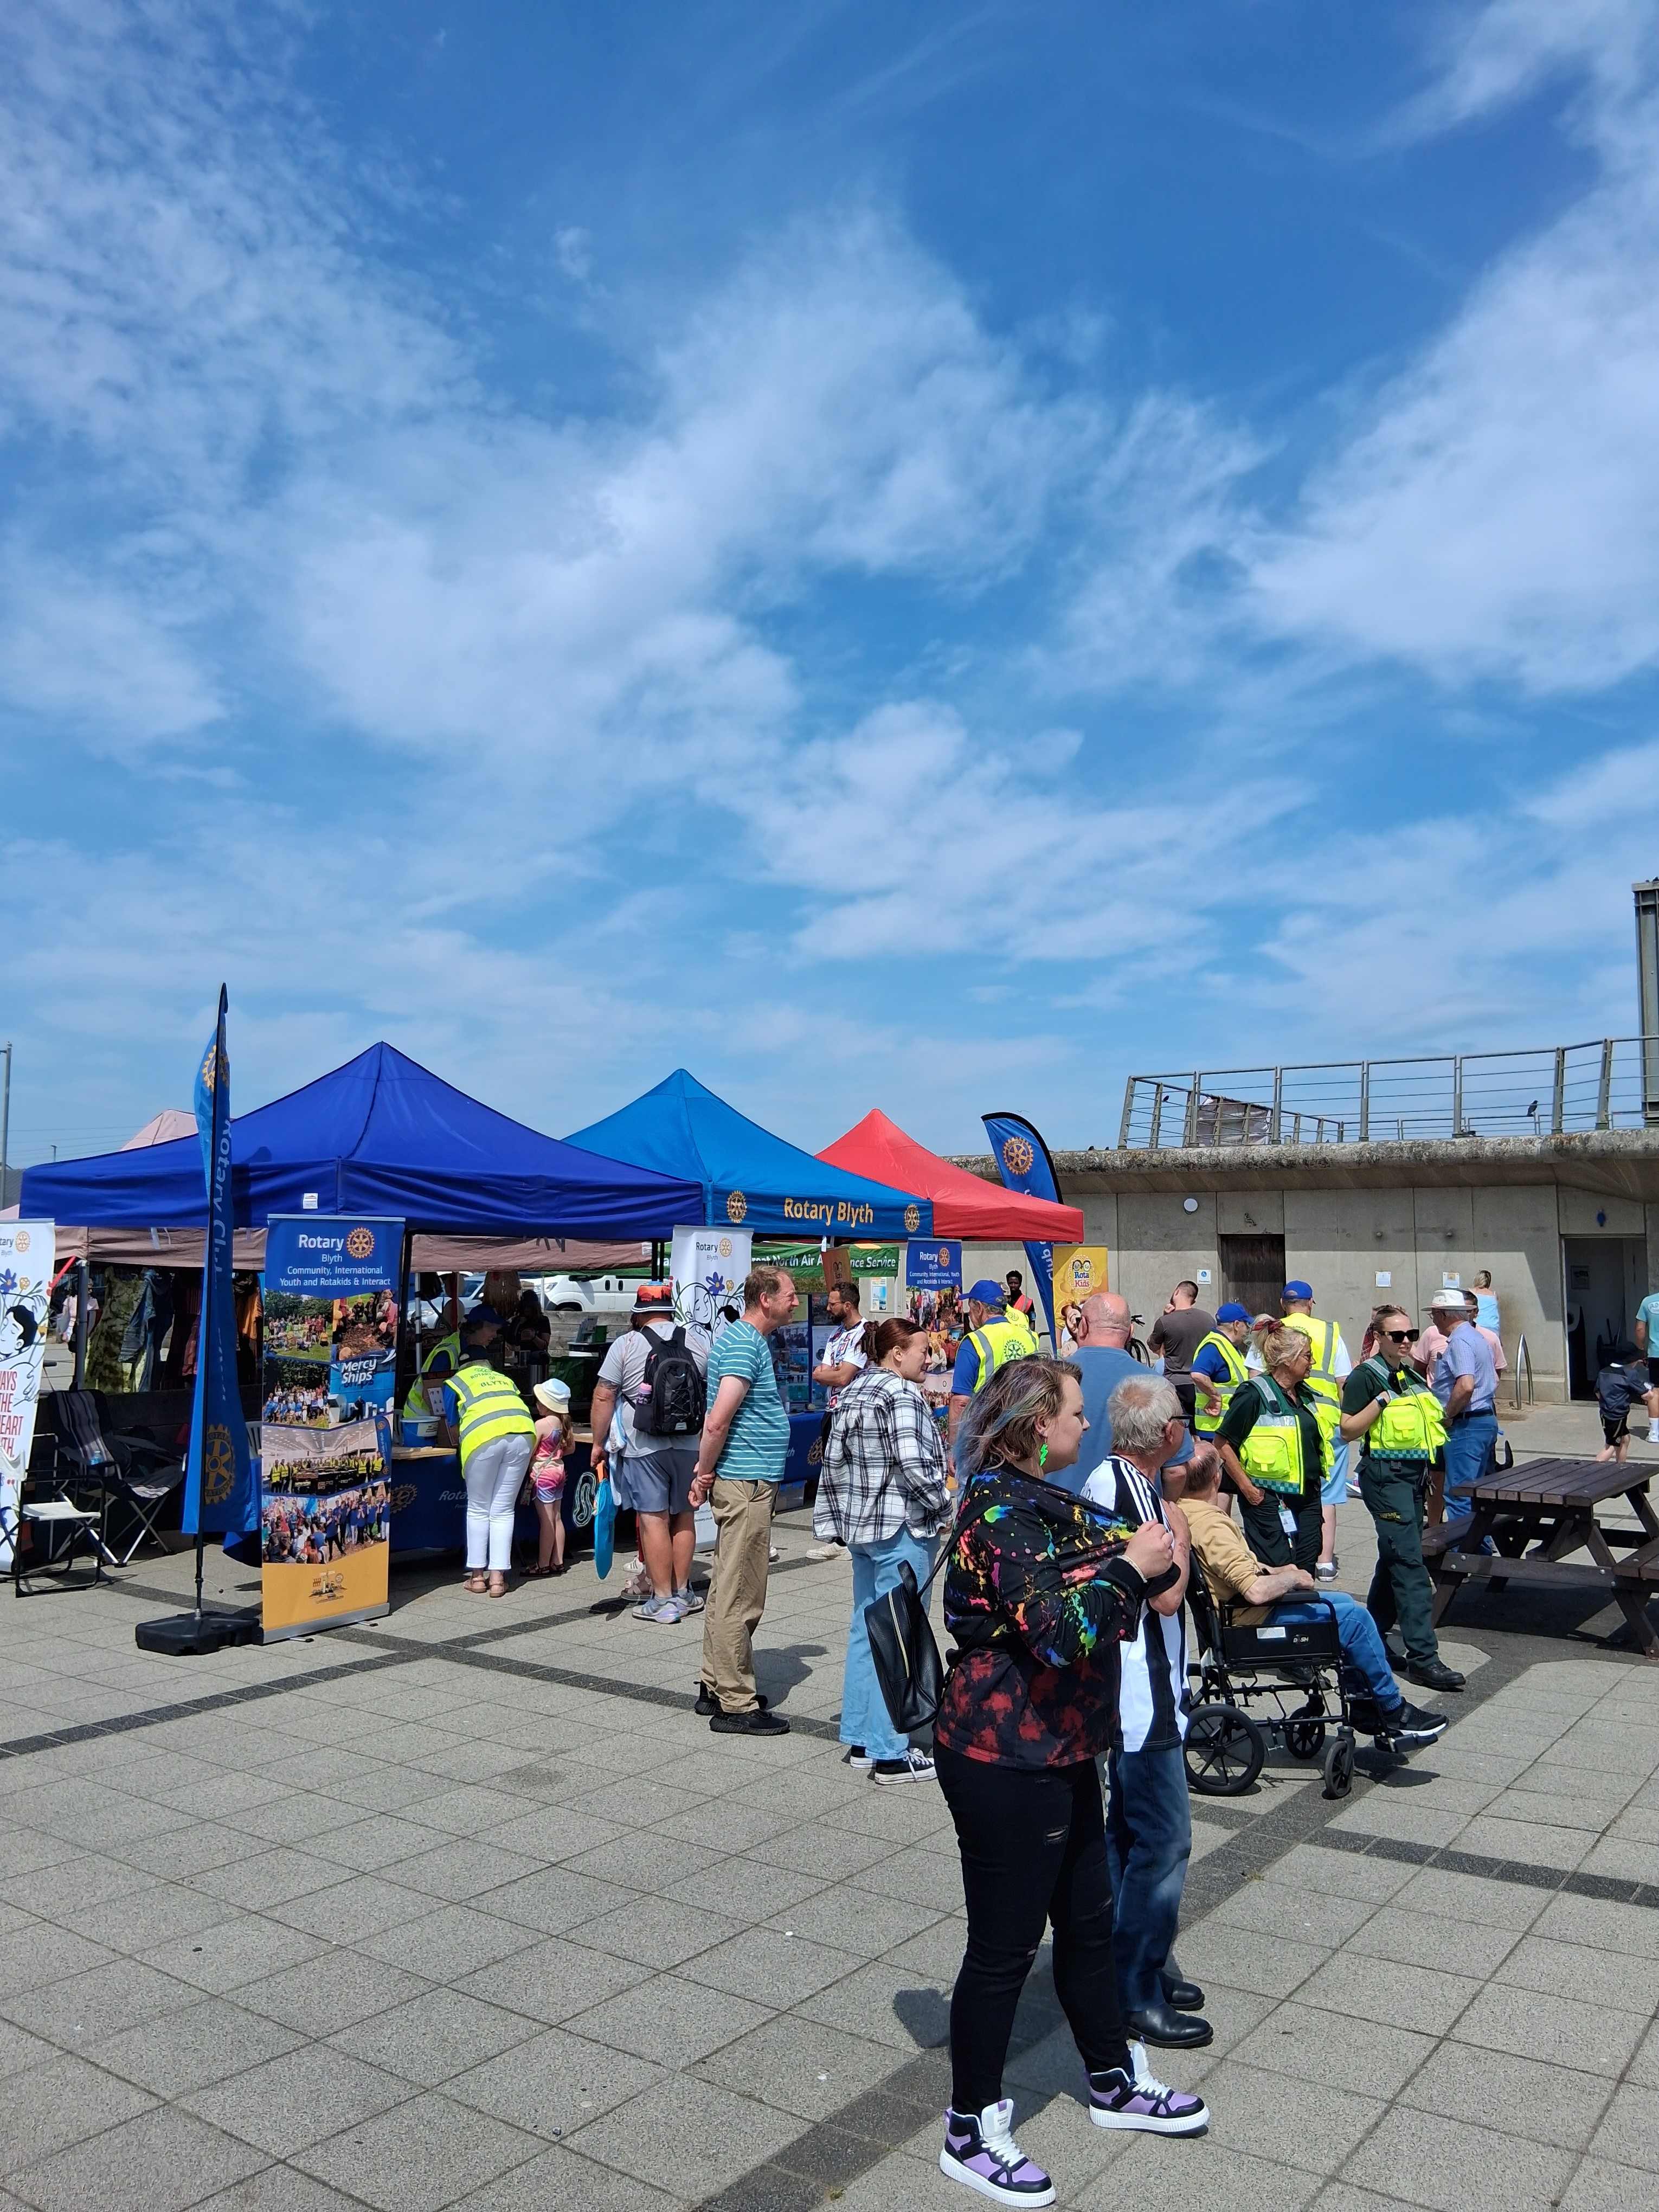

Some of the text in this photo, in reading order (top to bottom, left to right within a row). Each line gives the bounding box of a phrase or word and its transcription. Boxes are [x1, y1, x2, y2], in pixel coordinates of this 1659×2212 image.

[784, 1198, 873, 1228] Rotary Blyth
[0, 1238, 14, 1248] tary
[299, 1234, 344, 1251] Rotary
[696, 1242, 718, 1252] Rotary
[321, 1253, 343, 1264] Blyth
[772, 1255, 799, 1266] North
[801, 1253, 815, 1266] Air
[866, 1256, 896, 1268] Service
[919, 1251, 938, 1262] Rotary
[287, 1266, 383, 1276] Community, International
[280, 1277, 301, 1286] Youth
[304, 1277, 318, 1286] and
[320, 1277, 351, 1285] Rotakids
[362, 1277, 391, 1285] Interact
[341, 1359, 377, 1373] Mercy
[0, 1371, 17, 1391] AYS
[342, 1370, 373, 1384] Ships
[0, 1415, 24, 1436] EART
[439, 1490, 467, 1501] Rota
